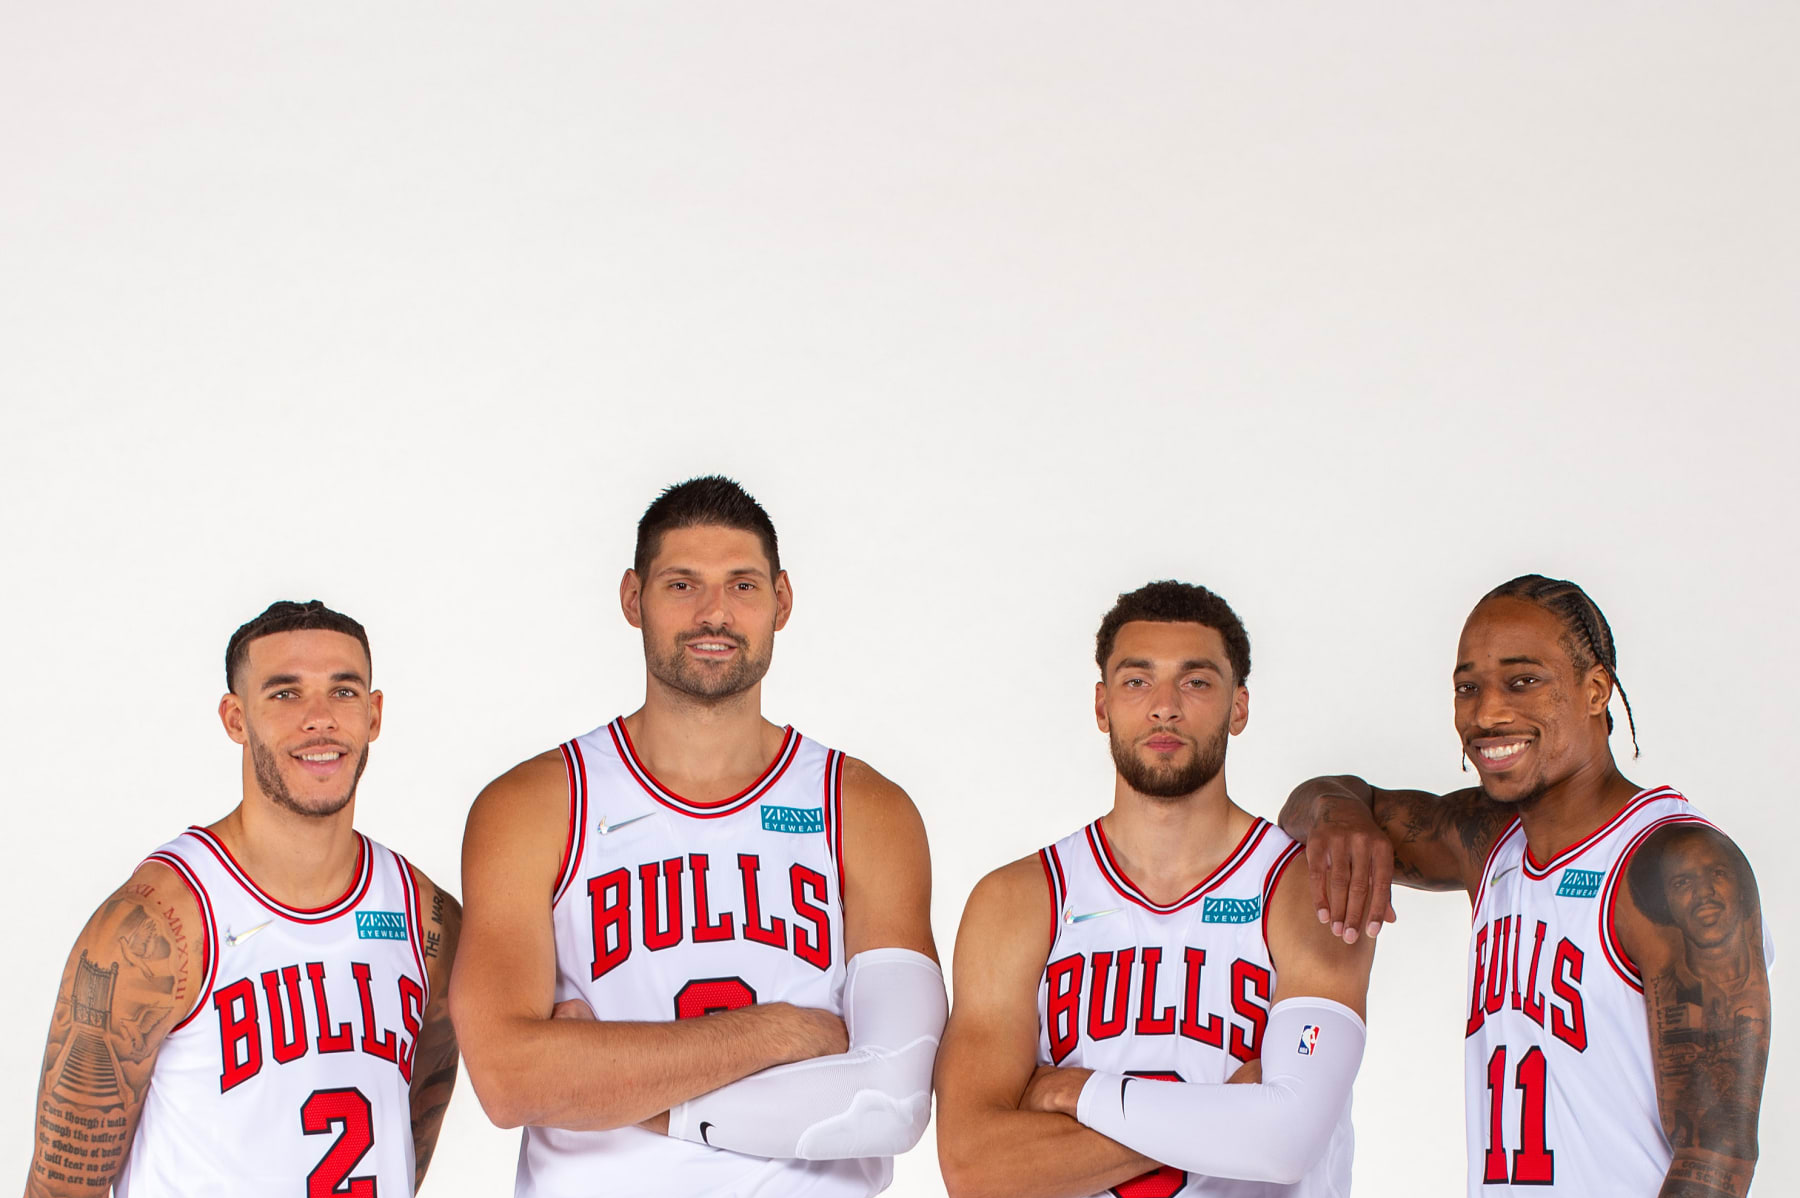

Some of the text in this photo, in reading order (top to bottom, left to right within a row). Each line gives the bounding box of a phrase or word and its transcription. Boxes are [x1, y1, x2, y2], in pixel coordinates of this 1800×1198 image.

[763, 808, 821, 823] ZENNI
[764, 822, 822, 832] EYEWEAR
[1206, 896, 1261, 913] ZENNI
[357, 913, 406, 928] ZENNI
[588, 853, 832, 982] BULLS
[1204, 911, 1260, 923] EYEWEAR
[359, 929, 406, 938] EYEWEAR
[425, 930, 441, 958] THE
[1046, 946, 1271, 1065] BULLS
[213, 961, 424, 1094] BULLS
[1482, 1044, 1555, 1186] 11
